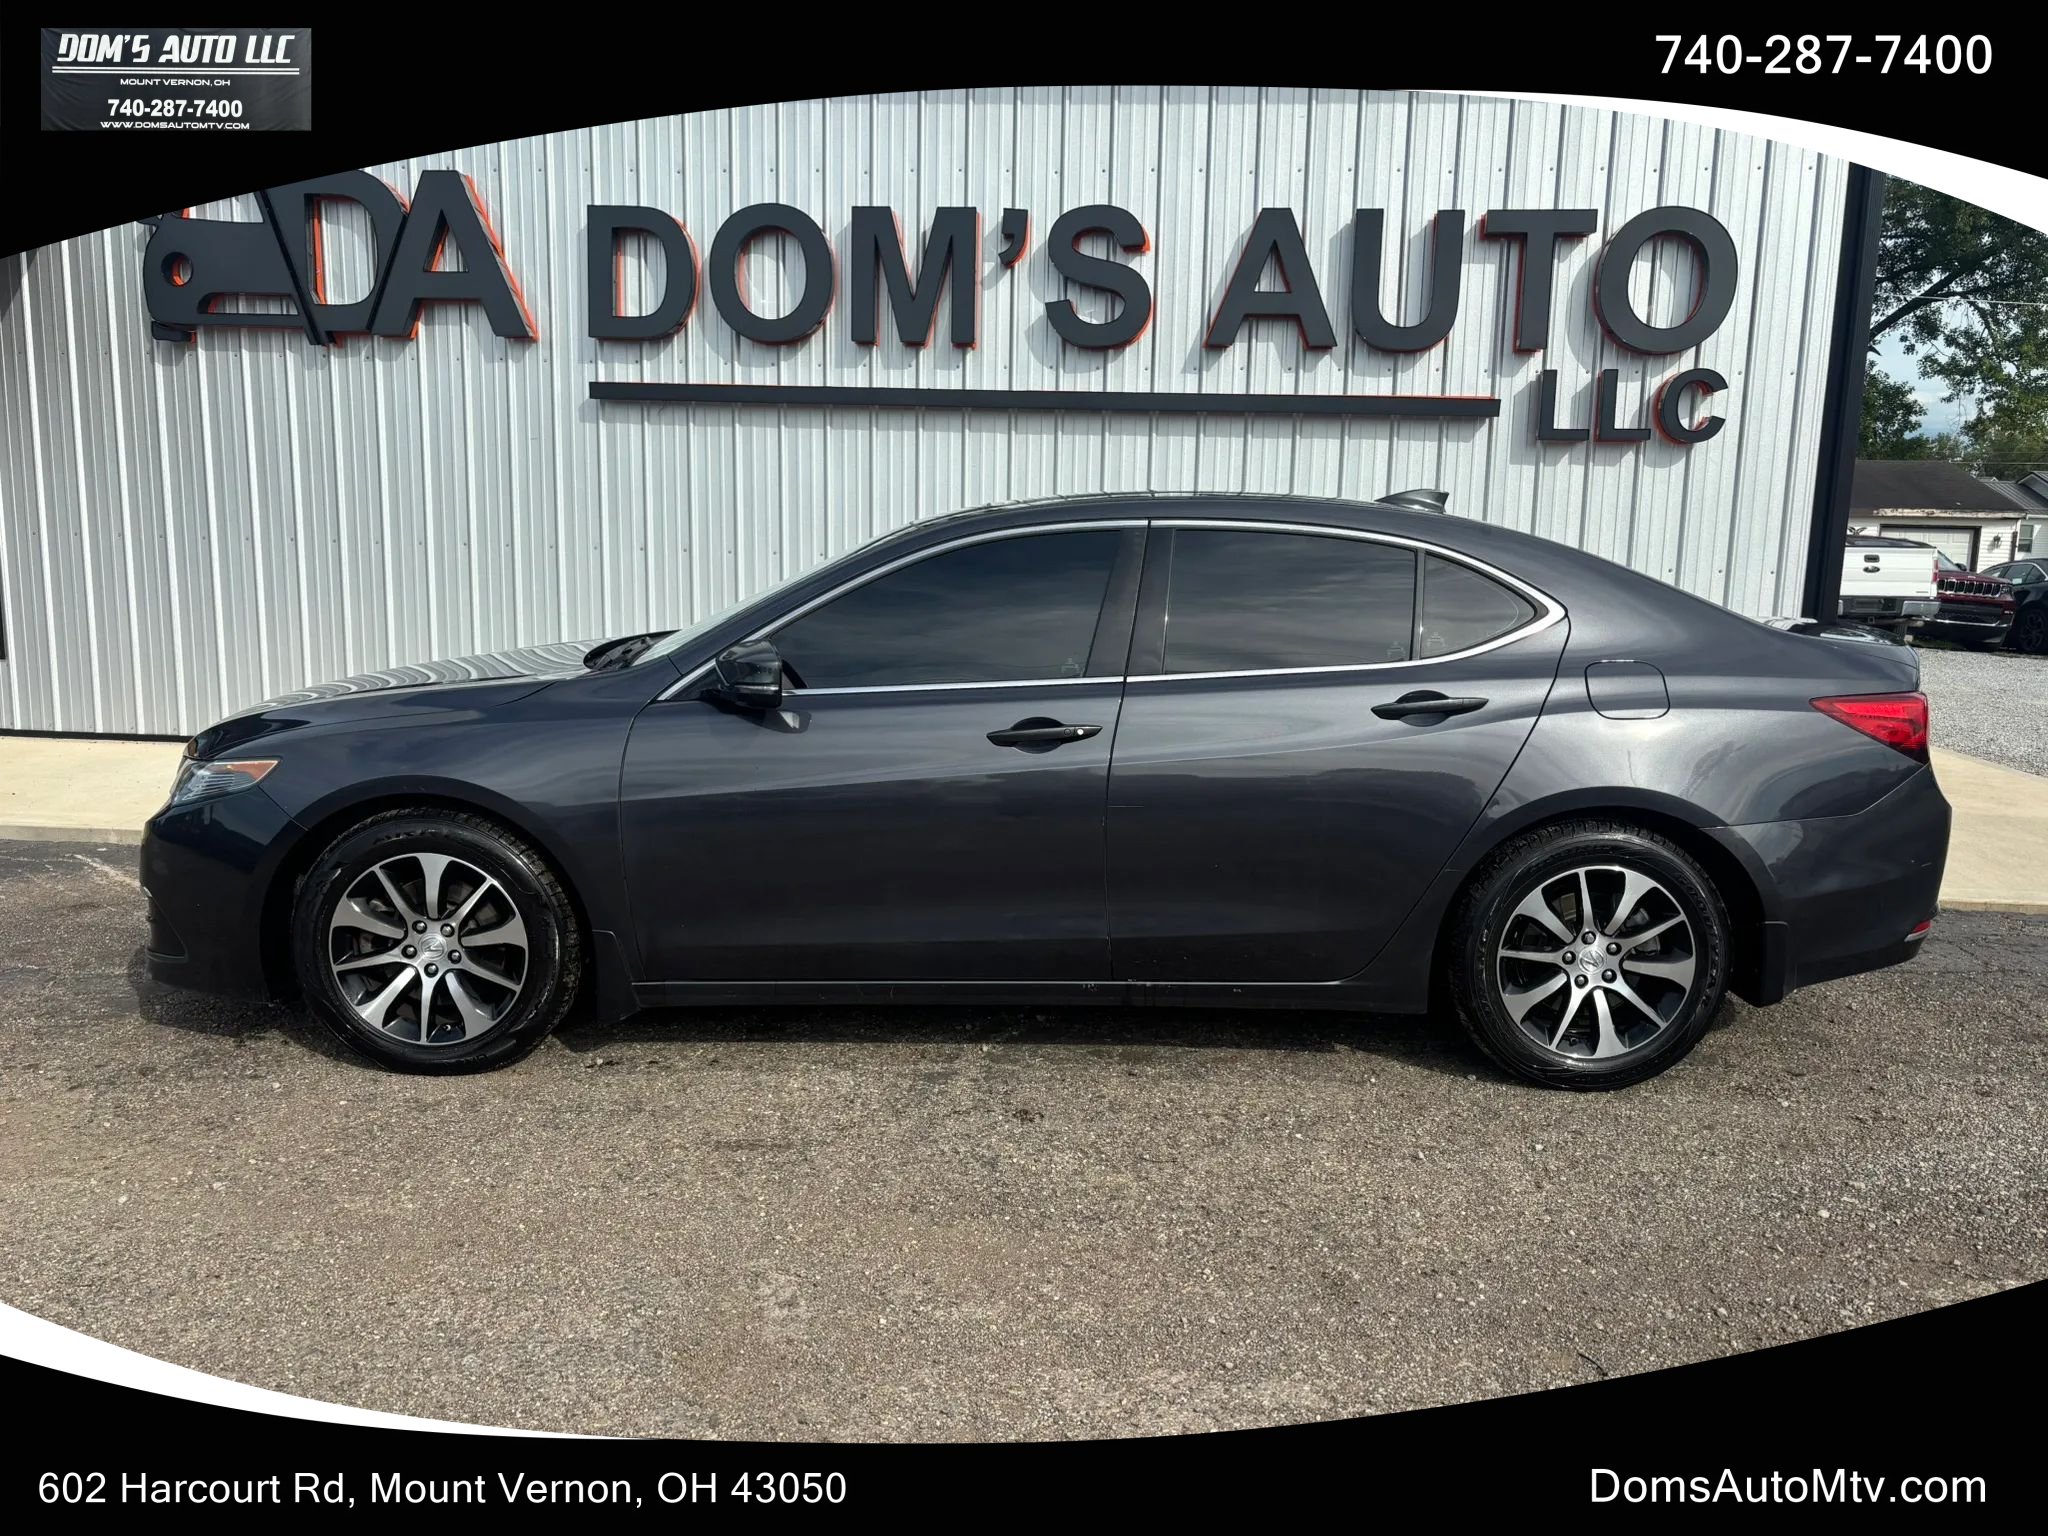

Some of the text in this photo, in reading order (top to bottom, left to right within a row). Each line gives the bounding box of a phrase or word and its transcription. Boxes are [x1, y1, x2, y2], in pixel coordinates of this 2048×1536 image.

[586, 201, 1739, 357] DOM'S AUTO
[1536, 366, 1730, 446] LLC
